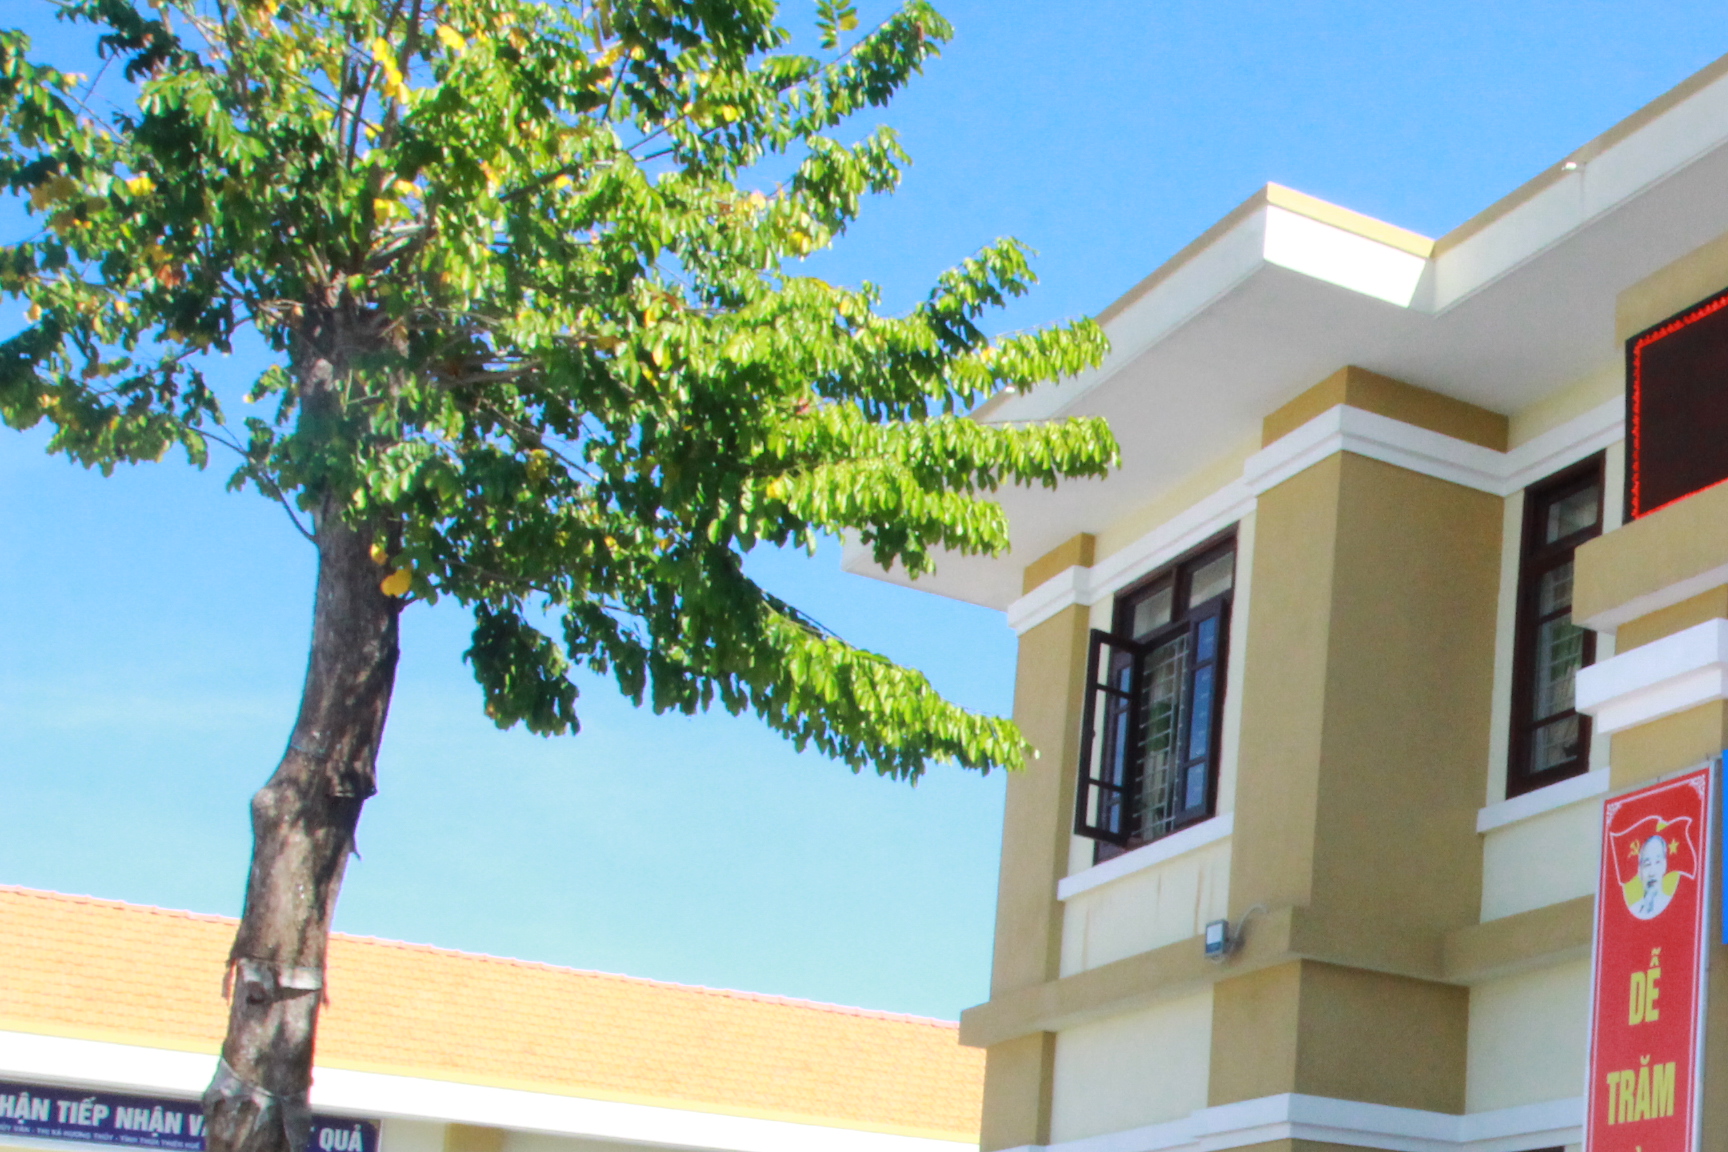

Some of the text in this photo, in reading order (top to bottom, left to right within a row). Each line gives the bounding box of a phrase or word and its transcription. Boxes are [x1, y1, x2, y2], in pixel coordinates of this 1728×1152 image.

[1628, 947, 1661, 1026] DỄ
[56, 1097, 110, 1127] TIẾP
[114, 1105, 183, 1137] NHẬN
[188, 1113, 206, 1137] V
[319, 1124, 364, 1152] QUẢ
[1607, 1055, 1676, 1126] TRĂM
